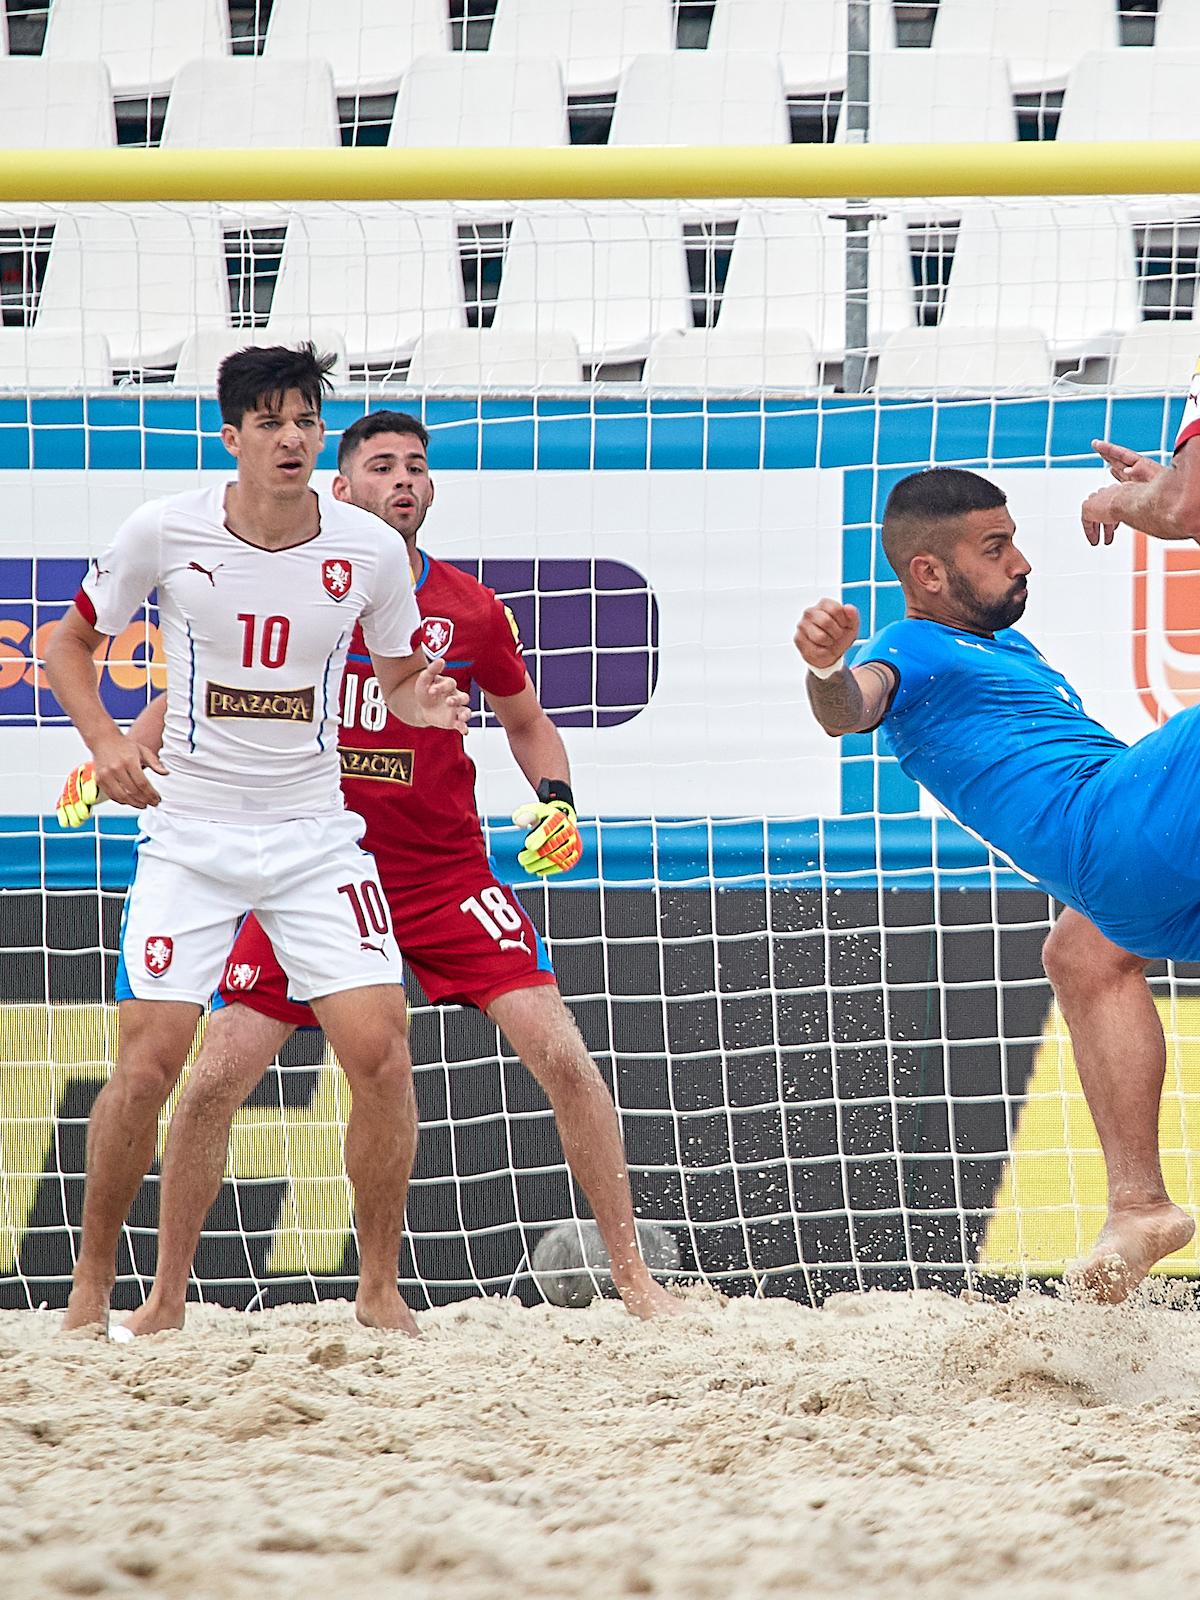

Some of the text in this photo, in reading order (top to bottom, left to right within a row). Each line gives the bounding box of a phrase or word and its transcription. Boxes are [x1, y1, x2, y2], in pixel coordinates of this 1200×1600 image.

[237, 613, 290, 669] 10
[342, 673, 389, 732] 18
[337, 879, 389, 938] 10
[459, 885, 522, 941] 18
